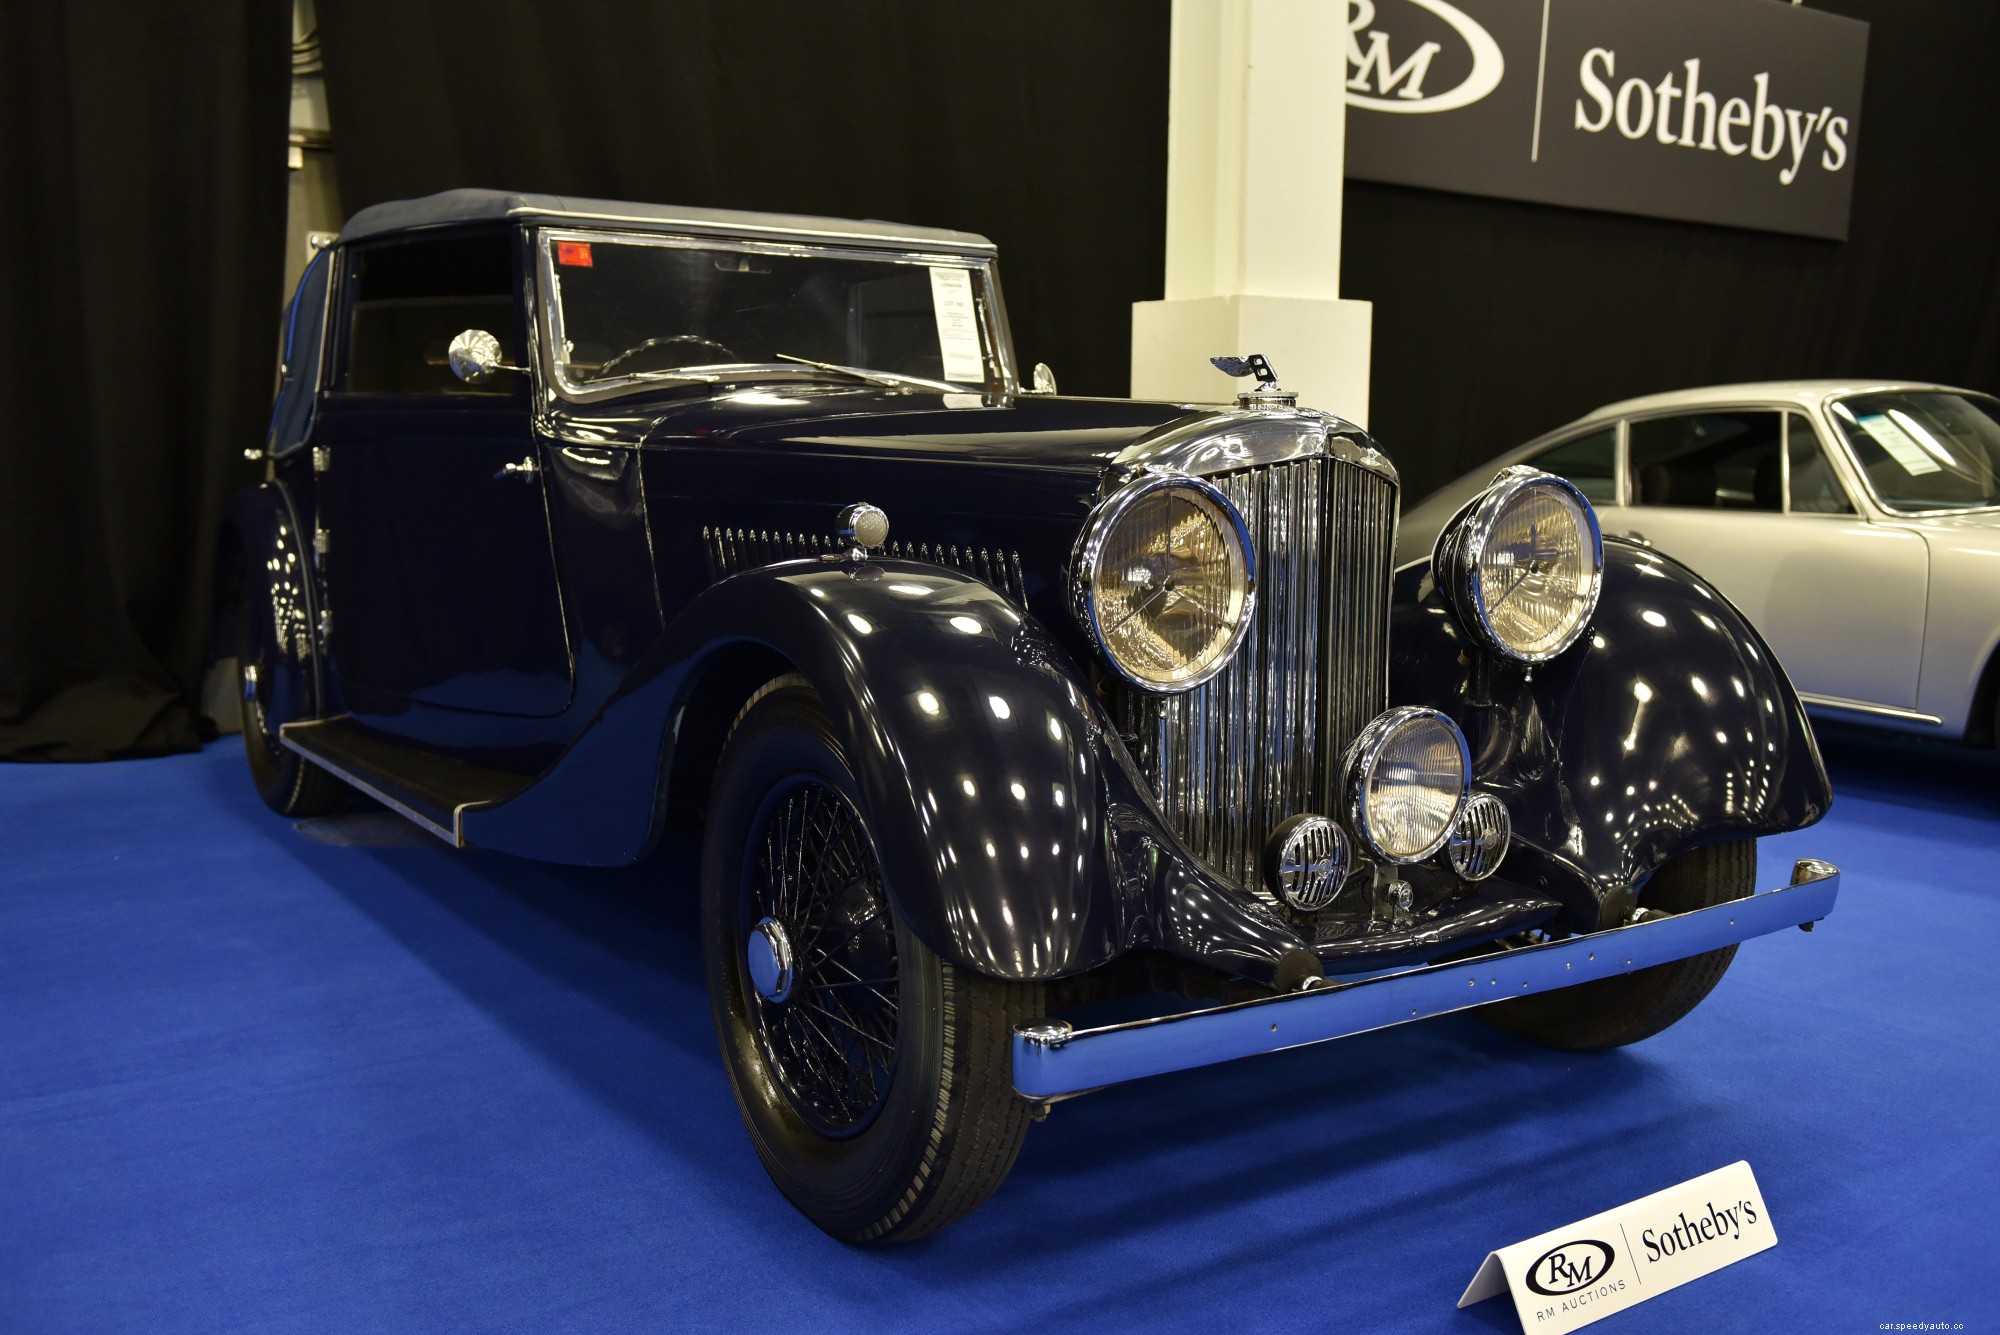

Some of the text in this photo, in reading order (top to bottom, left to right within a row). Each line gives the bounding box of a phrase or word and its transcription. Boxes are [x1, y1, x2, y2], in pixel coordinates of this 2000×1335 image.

[1574, 47, 1849, 185] Sotheby's
[1548, 1200, 1757, 1288] RM Sotheby's
[1536, 1279, 1626, 1322] RM AUCTIONS
